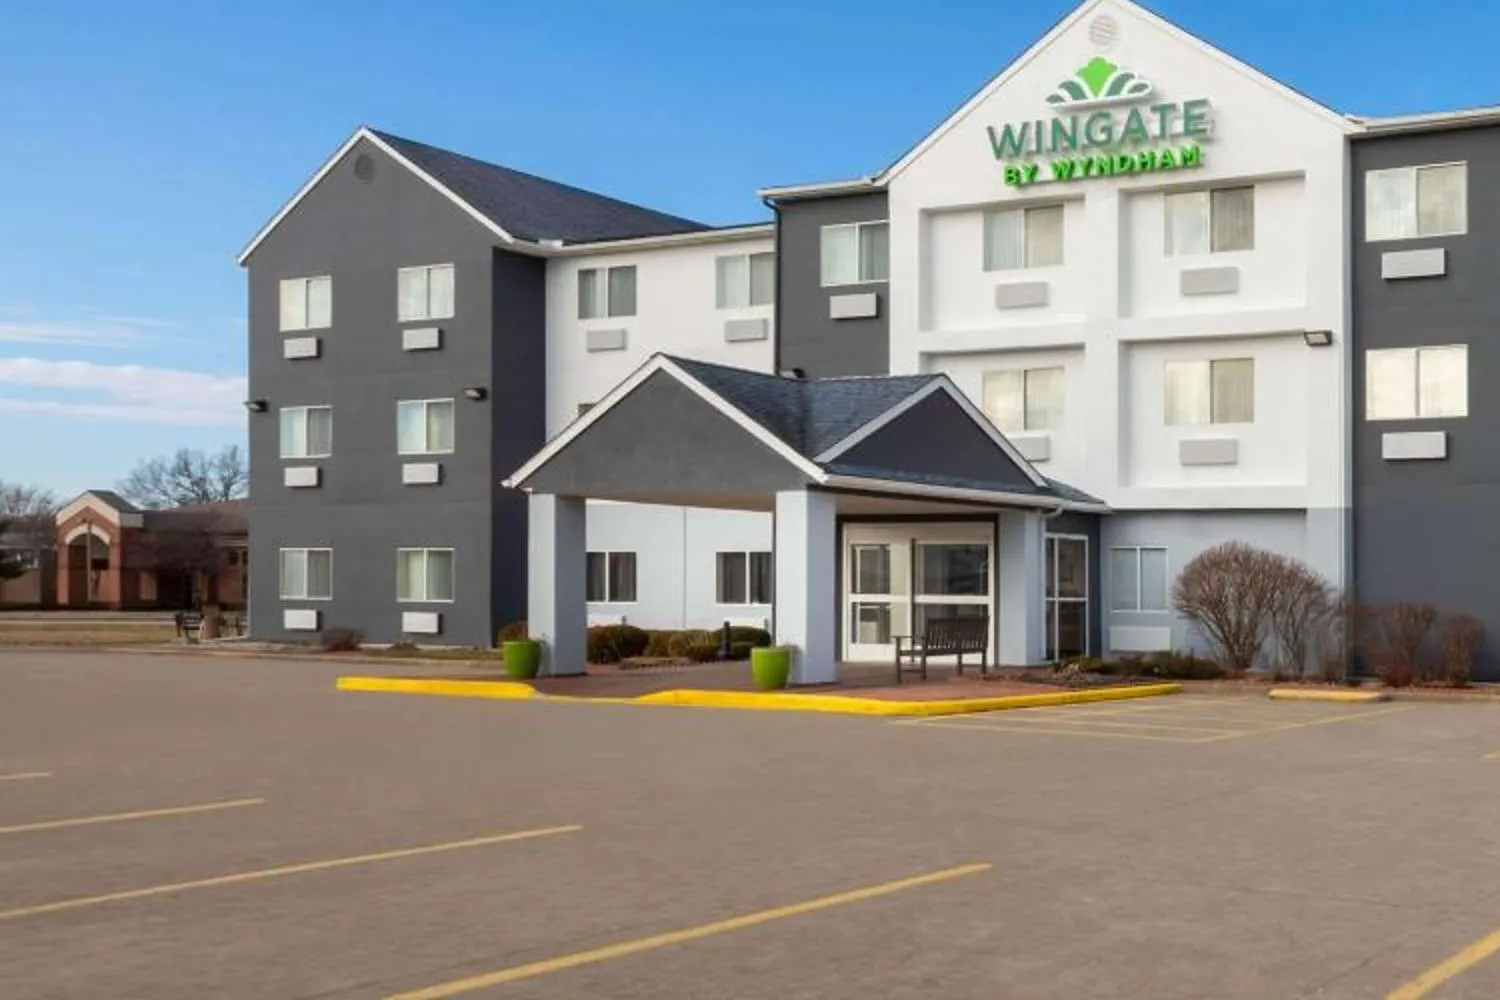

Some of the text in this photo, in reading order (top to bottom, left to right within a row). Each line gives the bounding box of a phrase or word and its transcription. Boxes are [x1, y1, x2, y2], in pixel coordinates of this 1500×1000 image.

[986, 99, 1211, 160] WINGATE
[1004, 145, 1203, 186] BY WYNDHAM
